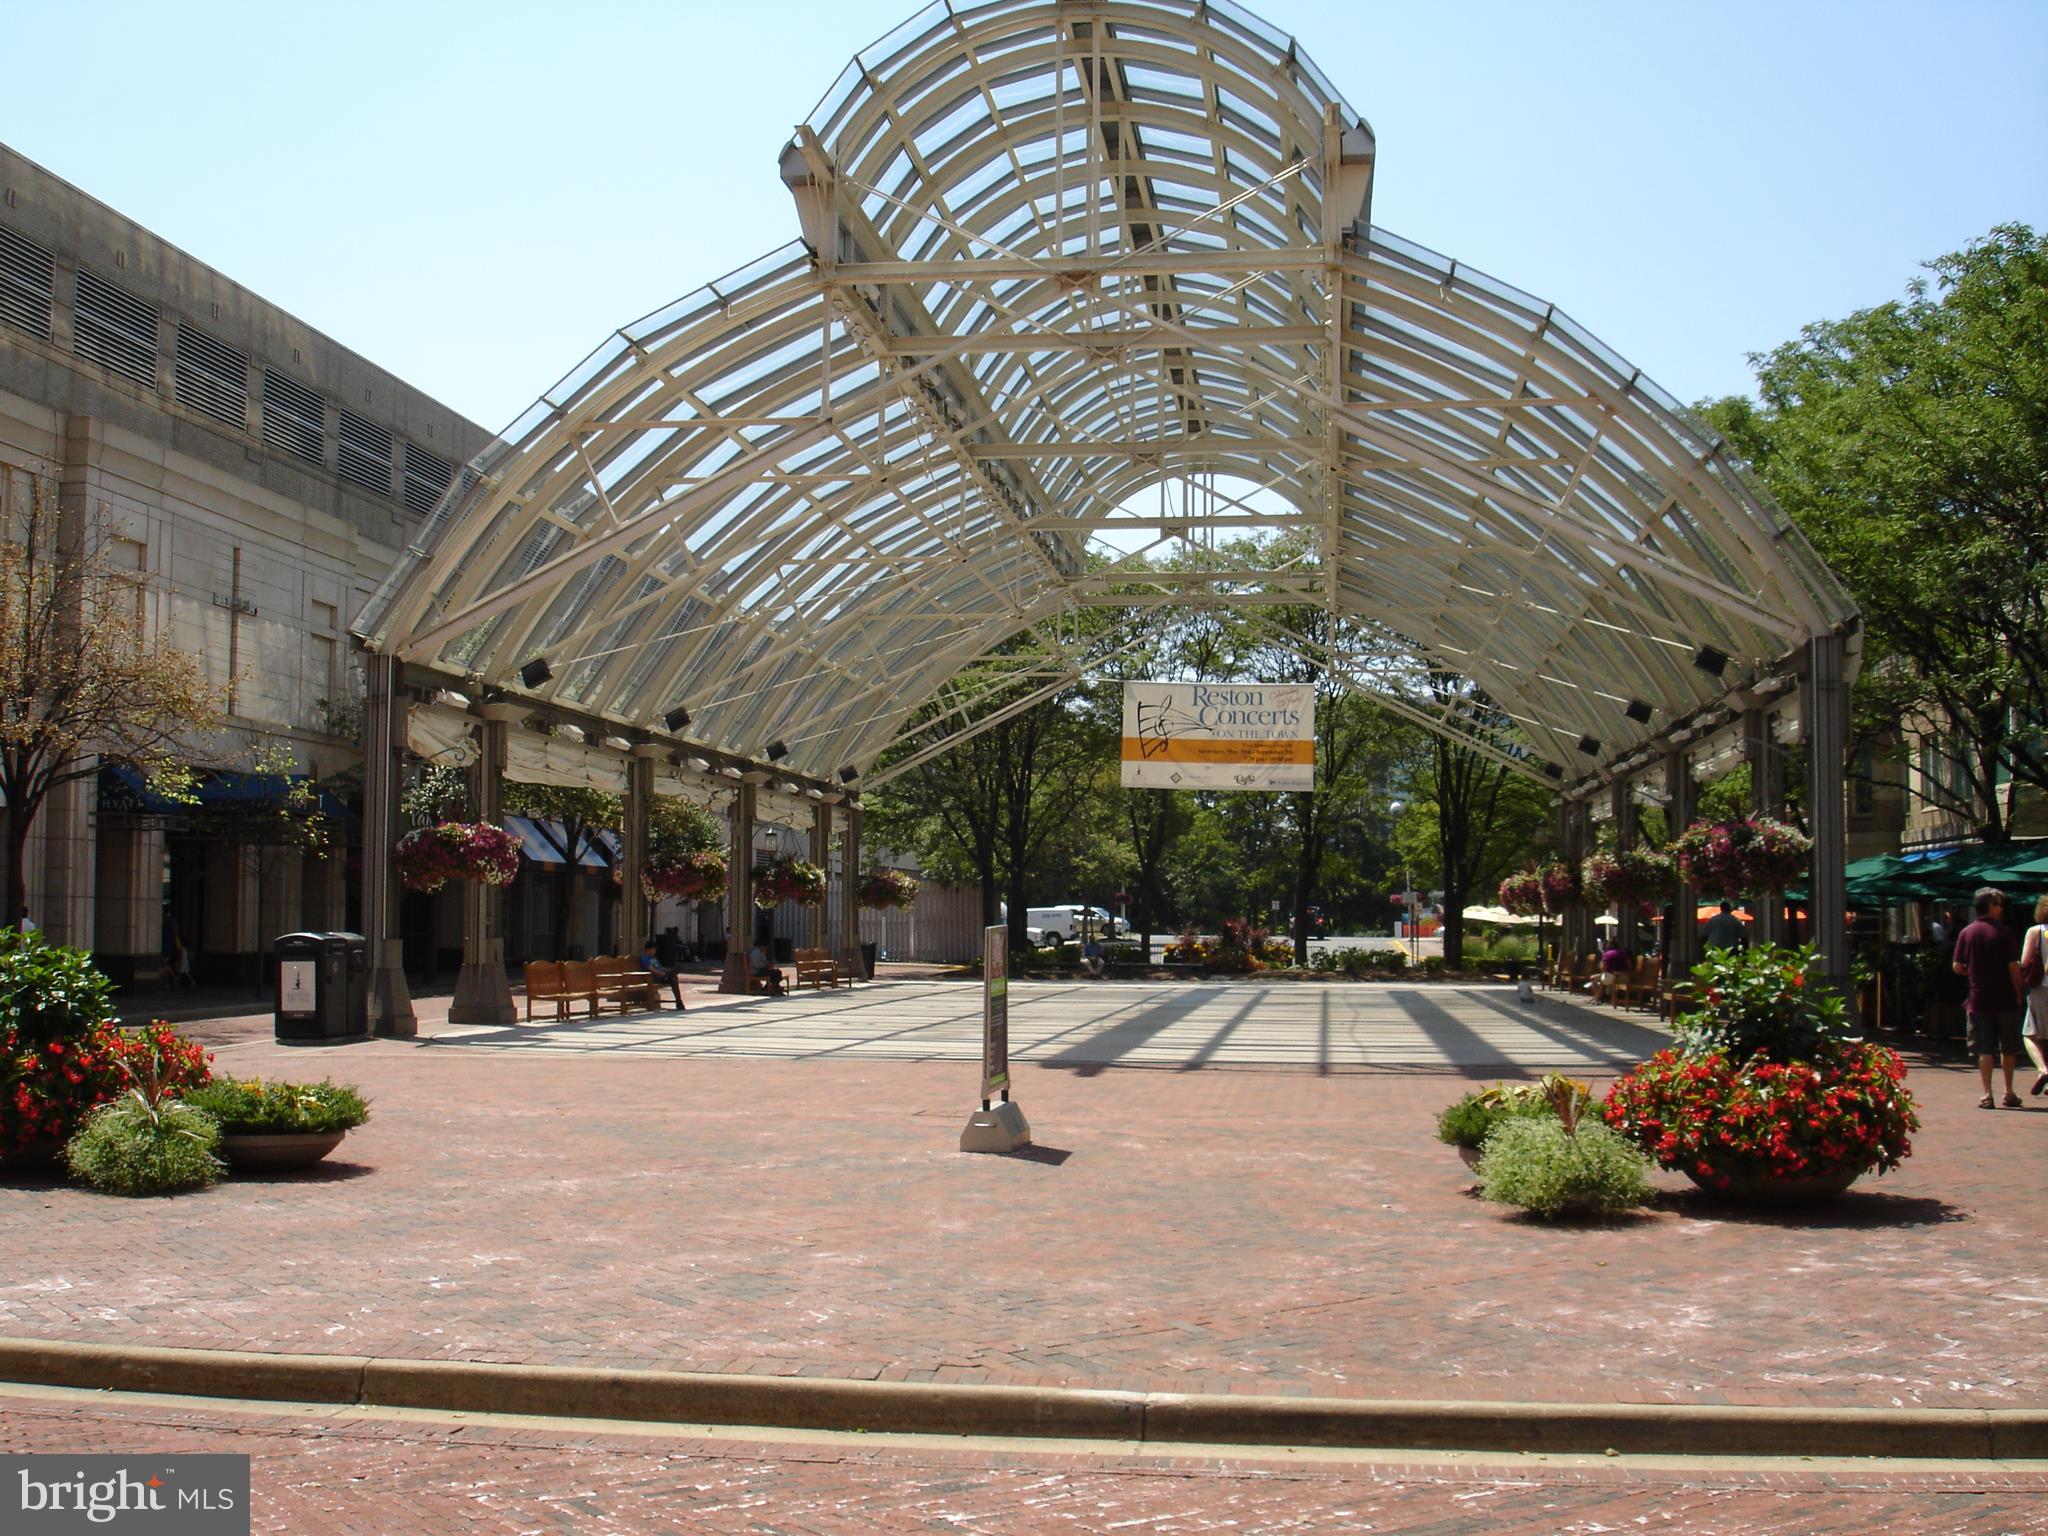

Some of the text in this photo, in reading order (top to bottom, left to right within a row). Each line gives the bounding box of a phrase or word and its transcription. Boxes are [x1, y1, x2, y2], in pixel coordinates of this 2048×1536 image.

[1192, 686, 1263, 707] Reston
[1199, 706, 1300, 726] Concerts
[1217, 730, 1299, 739] ON THE TOWN
